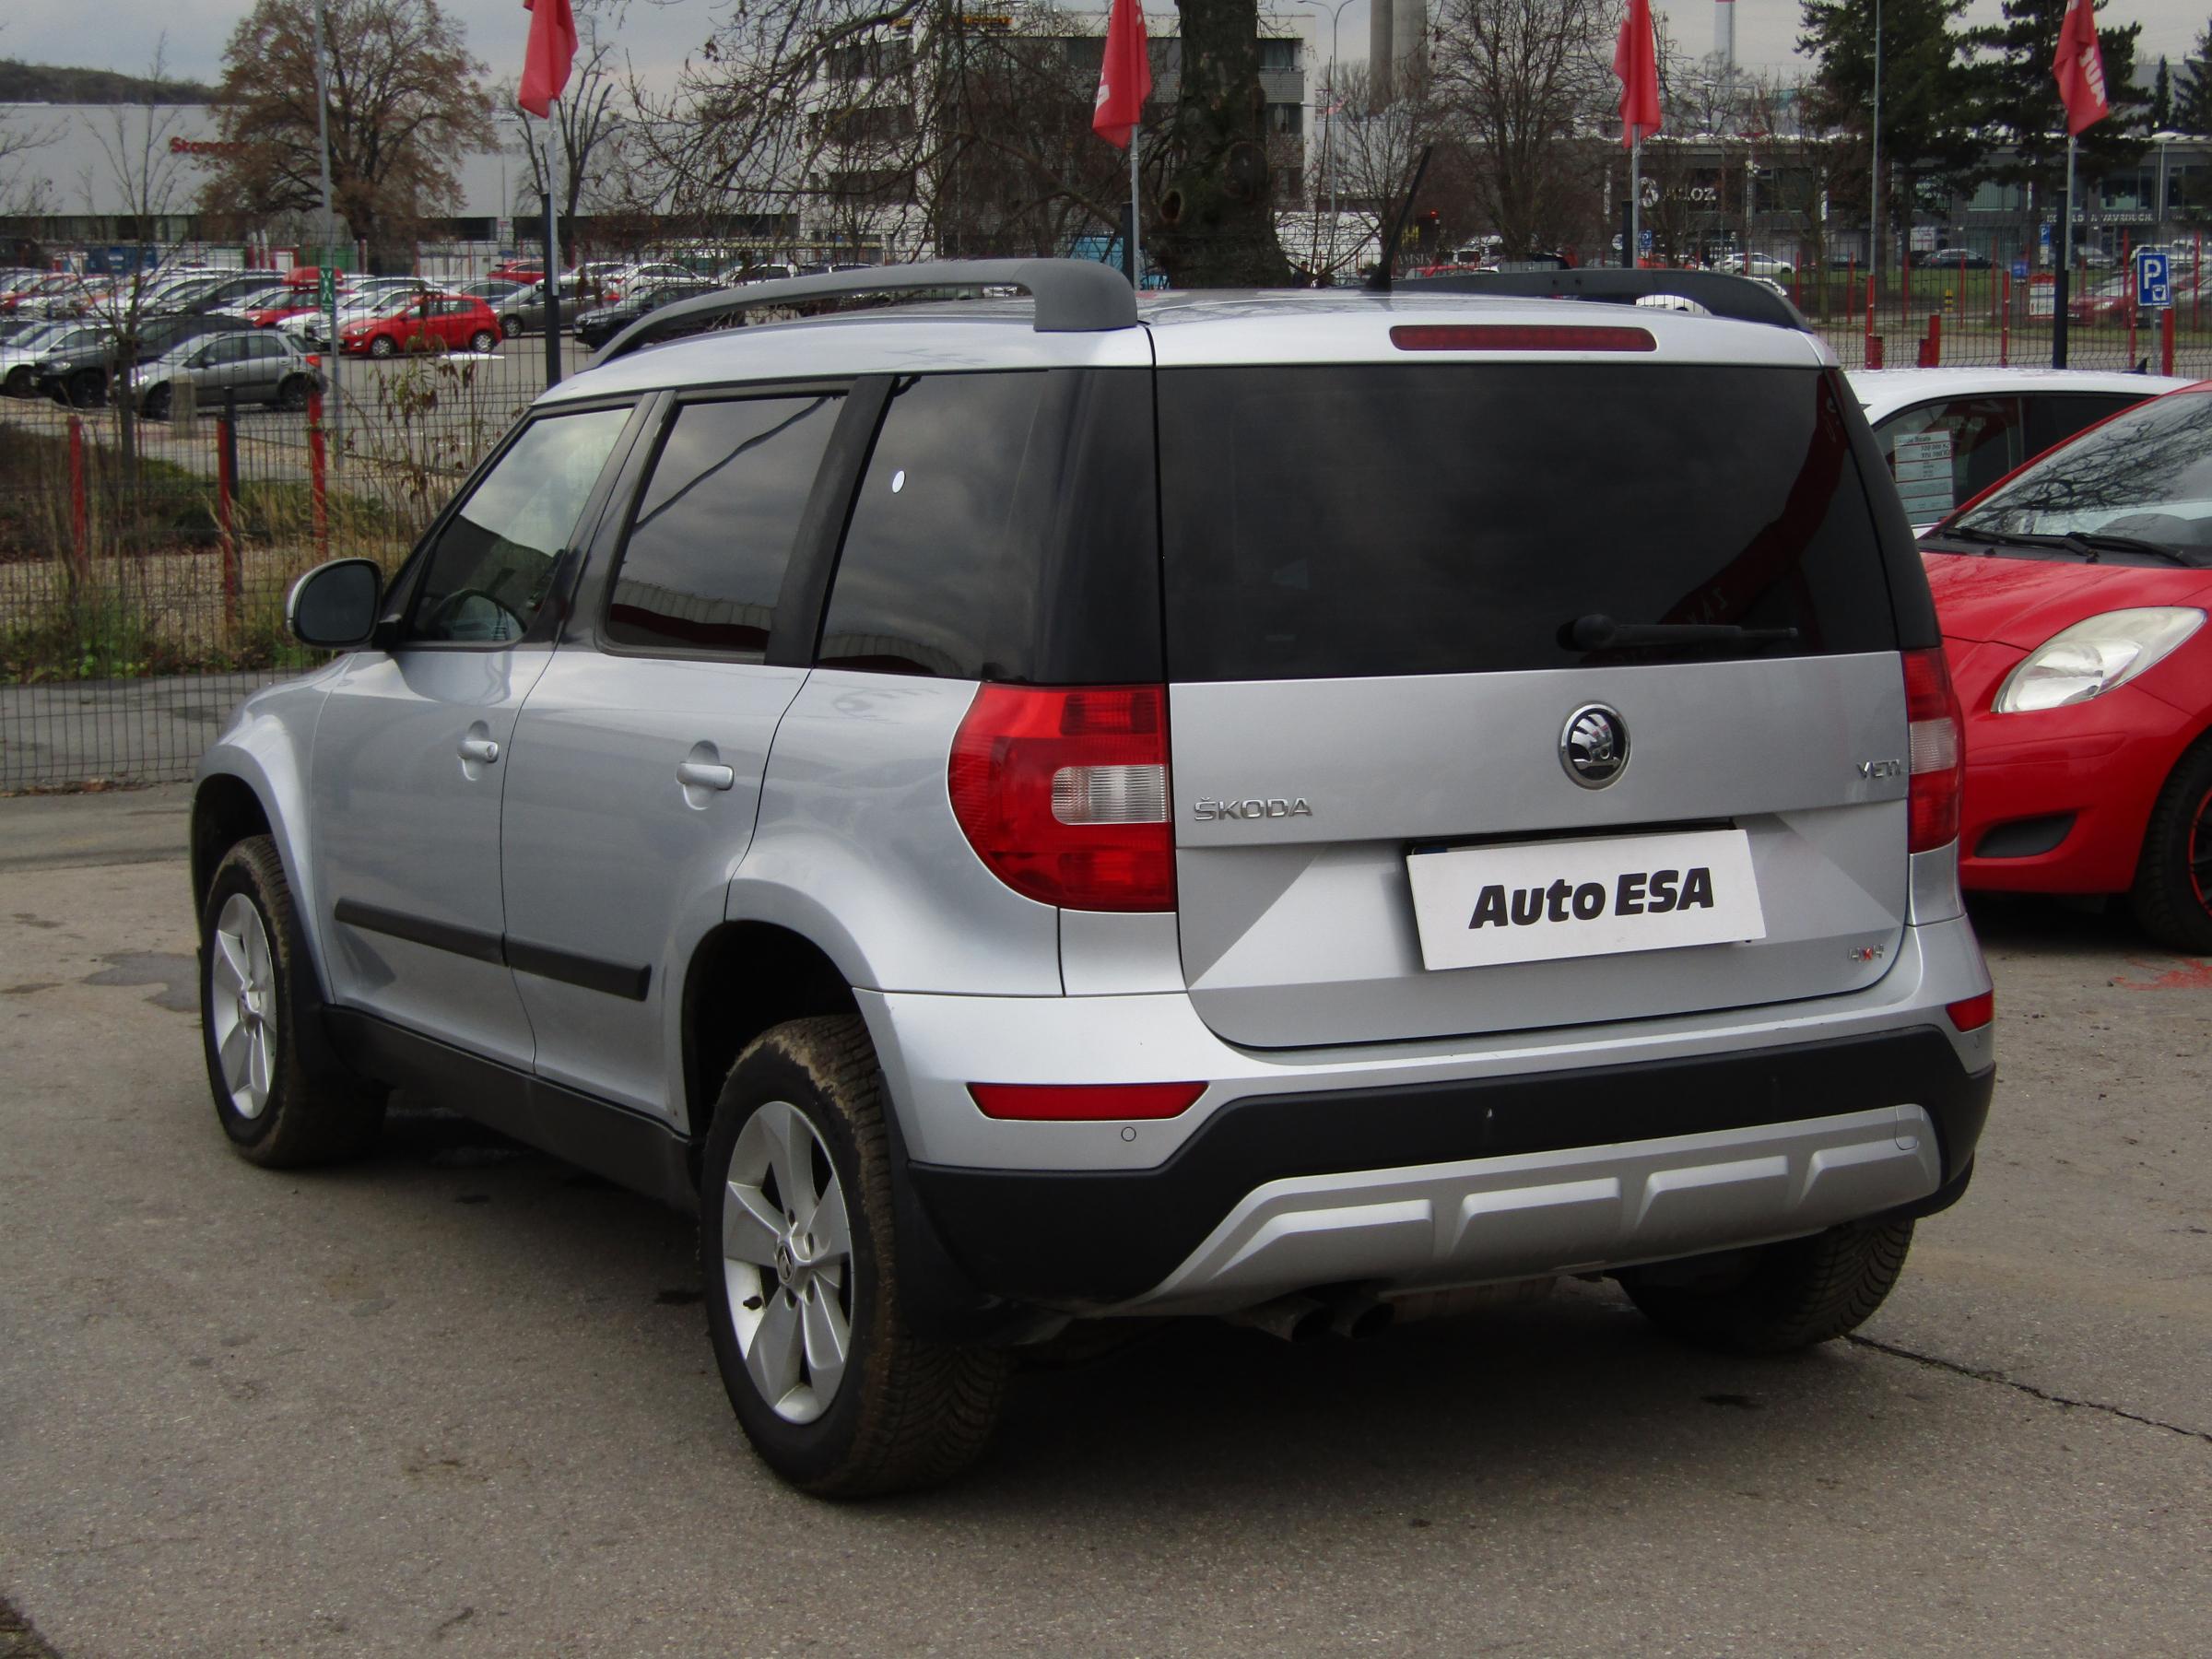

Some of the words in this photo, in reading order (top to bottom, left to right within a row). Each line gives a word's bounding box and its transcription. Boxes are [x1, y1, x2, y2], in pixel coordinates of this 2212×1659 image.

[2144, 259, 2161, 289] P
[1856, 759, 1900, 778] YETI
[1194, 796, 1313, 821] ŠKODA
[1468, 878, 1606, 930] Auto
[1615, 867, 1714, 916] ESA
